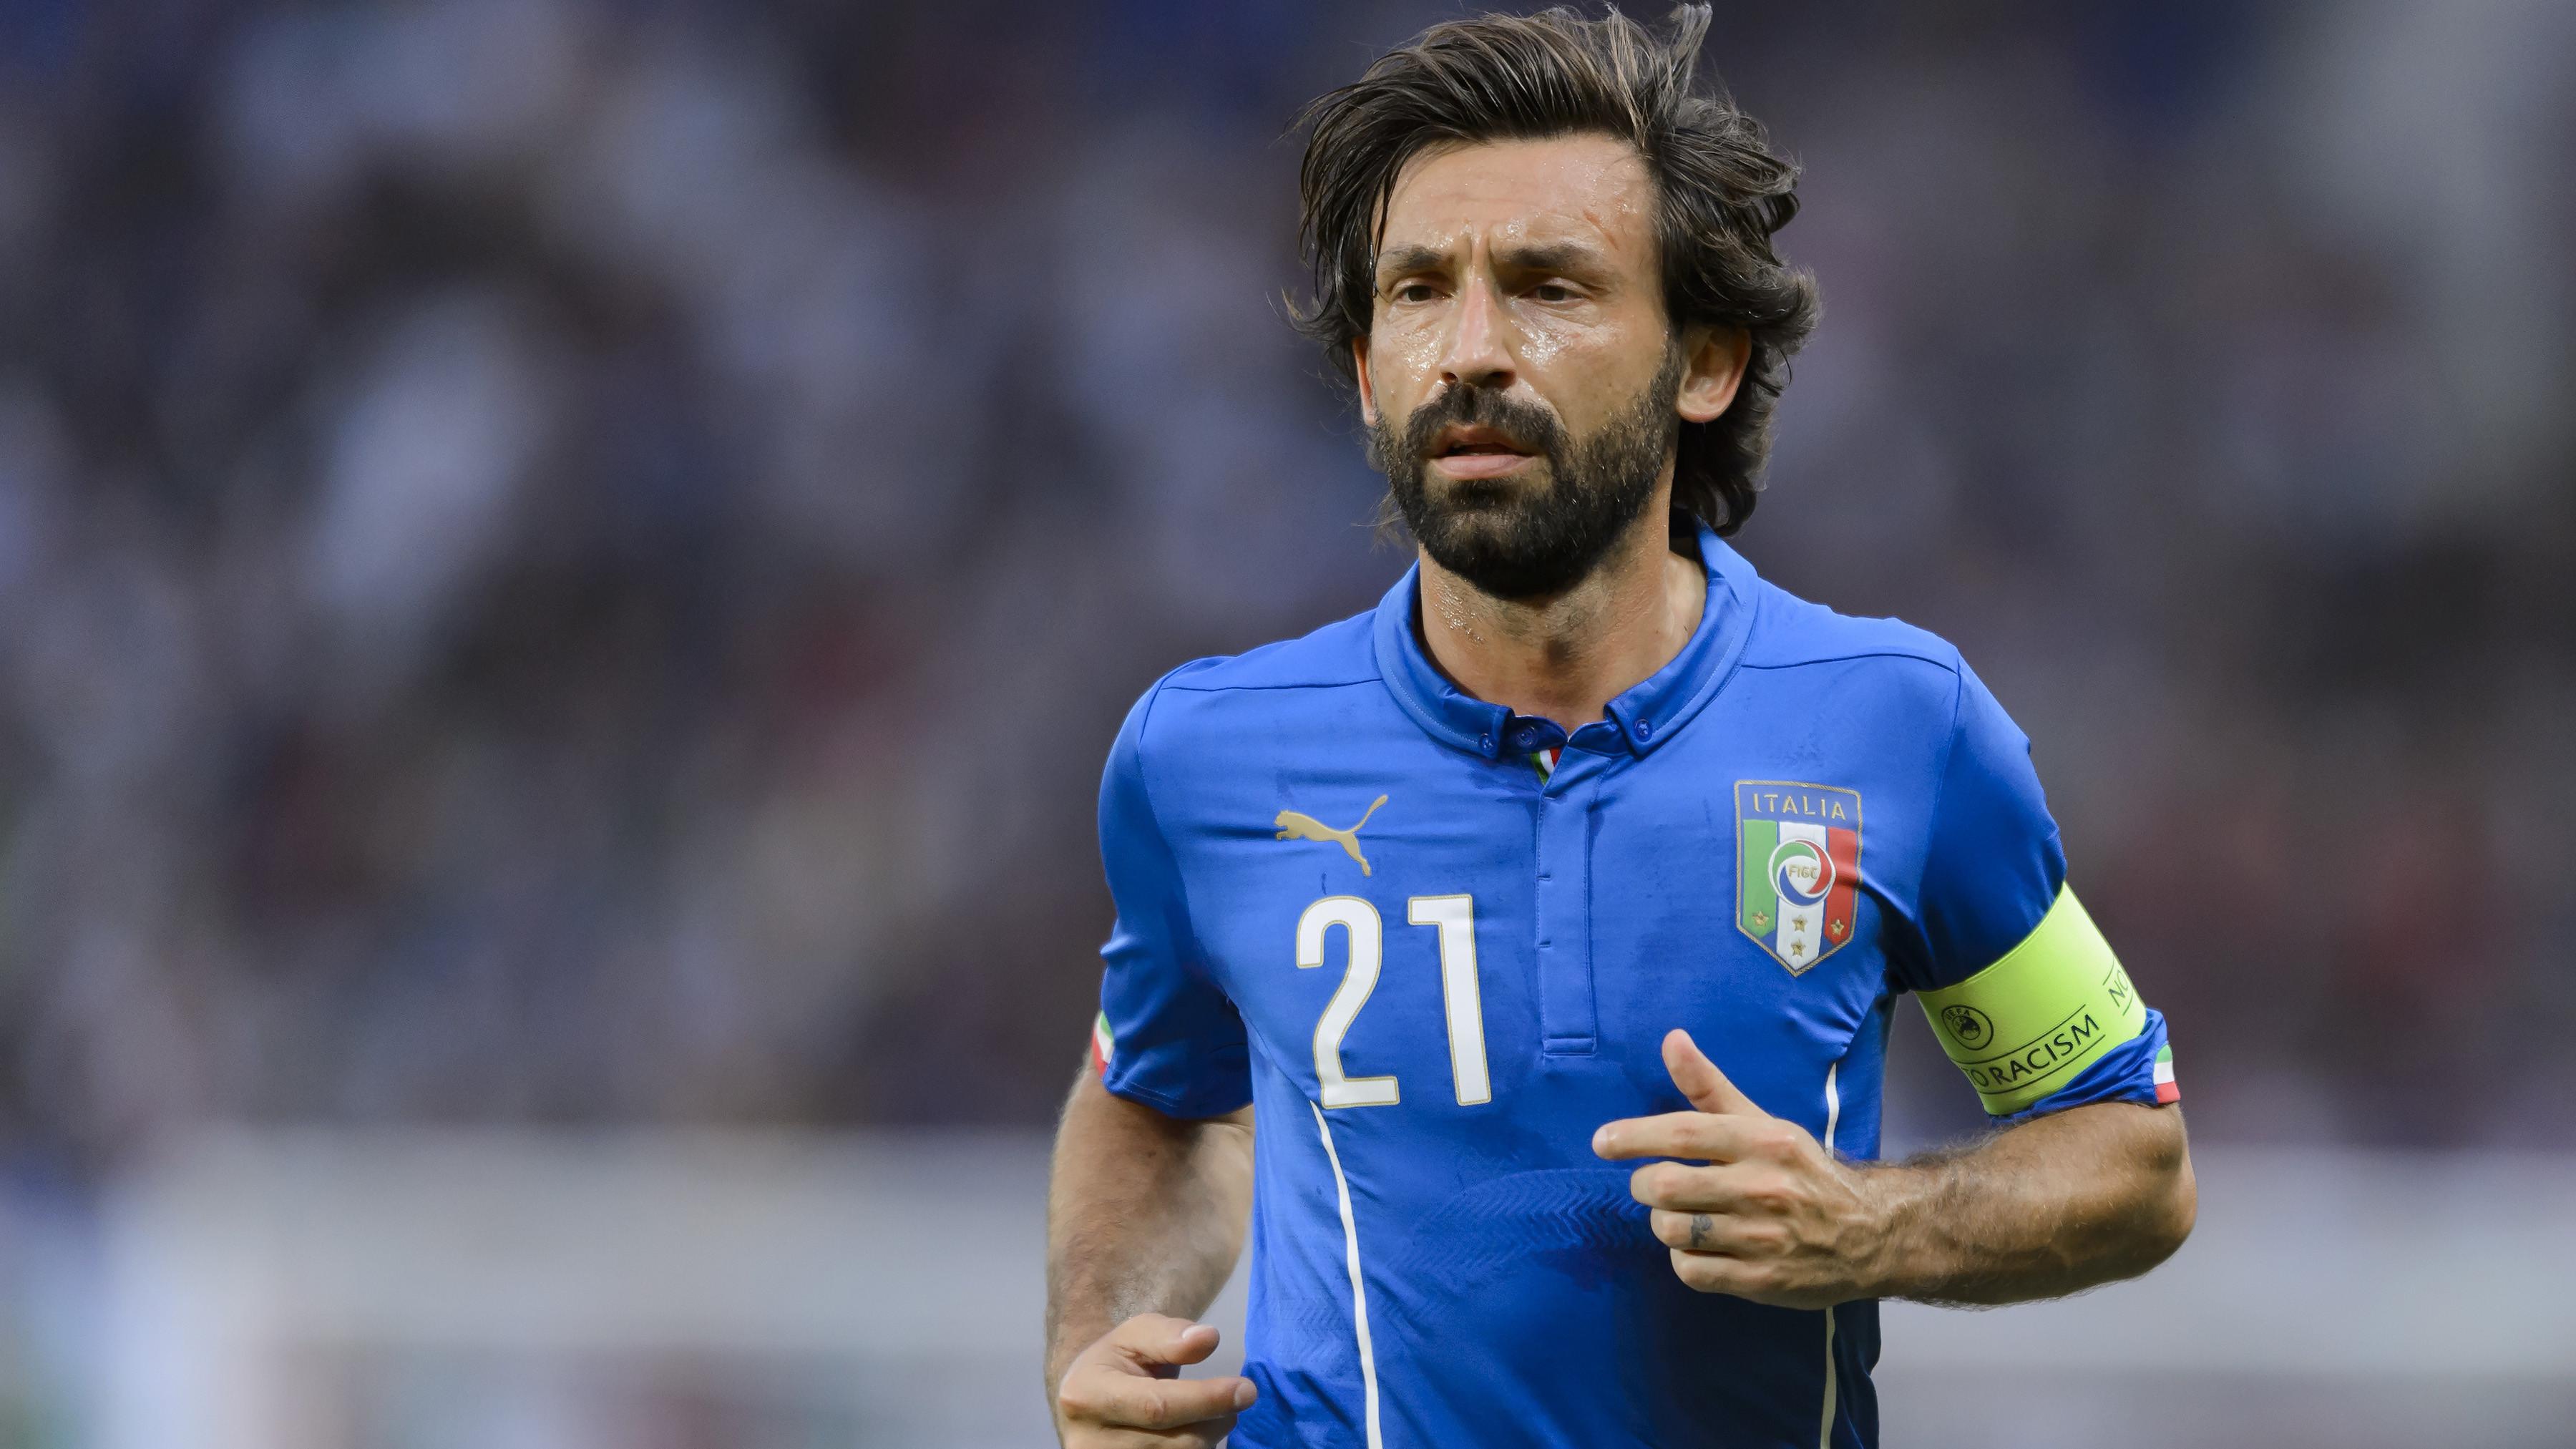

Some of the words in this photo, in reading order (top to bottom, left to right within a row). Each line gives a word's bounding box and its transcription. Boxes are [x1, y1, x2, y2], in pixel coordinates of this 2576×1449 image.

[1753, 794, 1846, 821] ITALIA
[1788, 864, 1818, 879] FIGC
[1296, 894, 1492, 1110] 21
[1989, 1013, 2100, 1085] RACISM
